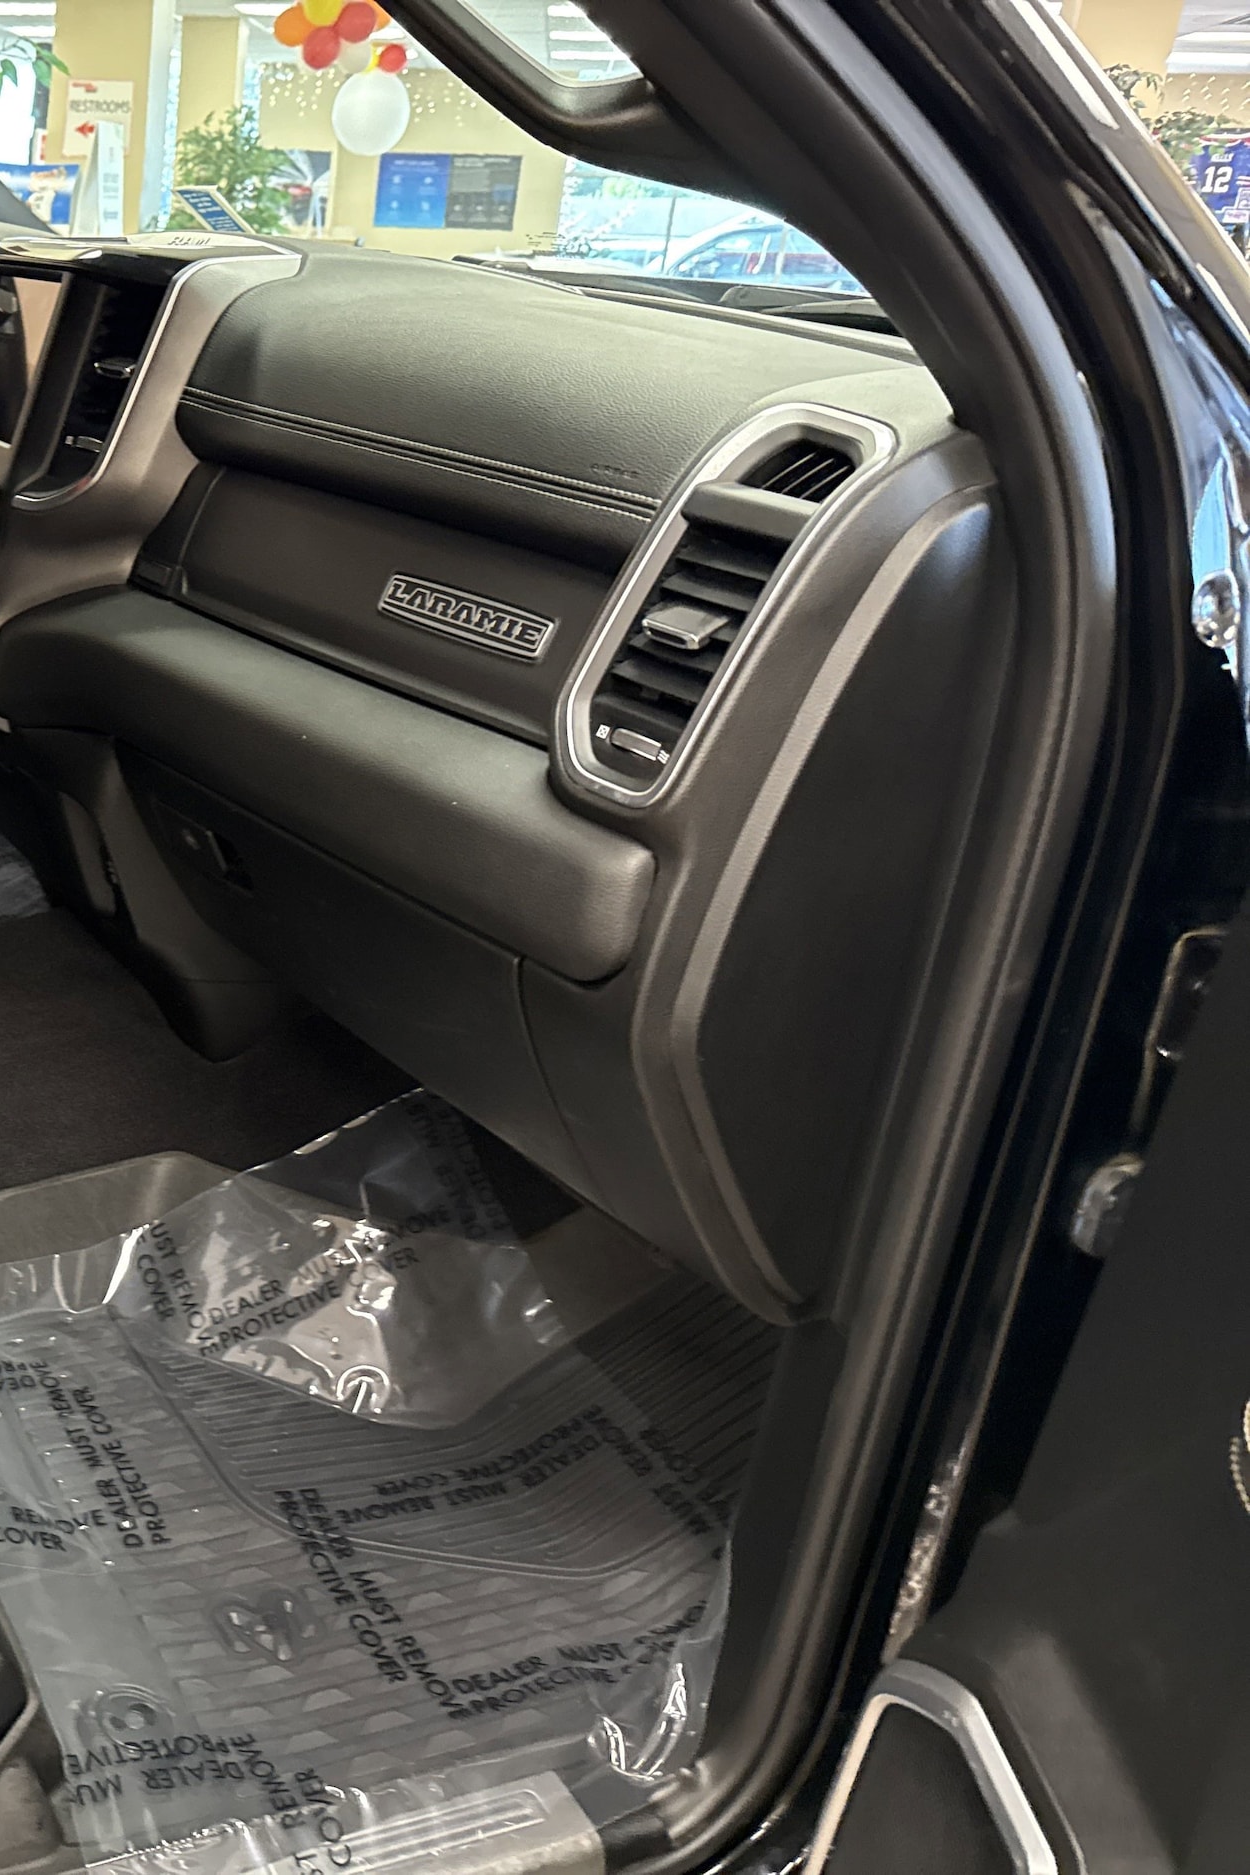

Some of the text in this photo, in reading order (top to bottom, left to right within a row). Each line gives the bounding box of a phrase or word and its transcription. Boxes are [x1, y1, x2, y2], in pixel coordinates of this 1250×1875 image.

[70, 100, 131, 113] RESTROOMS
[1201, 166, 1233, 193] 12
[386, 580, 546, 649] LARAMIE
[137, 1254, 176, 1322] COVER
[150, 1222, 221, 1357] UST REMOVE
[209, 1278, 285, 1326] DEALER
[217, 1279, 342, 1349] PROTECTIVE
[31, 1360, 144, 1549] DEALER MUST REMOVE
[72, 1386, 172, 1545] PROTECTIVE COVER
[335, 1494, 435, 1524] REMOVE
[372, 1472, 448, 1496] COVER
[443, 1481, 507, 1506] MUST
[11, 1506, 107, 1536] REMOVE
[274, 1490, 408, 1684] PROTECTIVE COVER
[300, 1488, 472, 1721] DEALER MUST REMOVE
[452, 1655, 548, 1695] DEALER
[555, 1641, 630, 1664] MUST
[469, 1665, 620, 1715] PROTECTIVE
[66, 1734, 230, 1777] PROTECTIVE
[67, 1759, 245, 1806] DEALER MU
